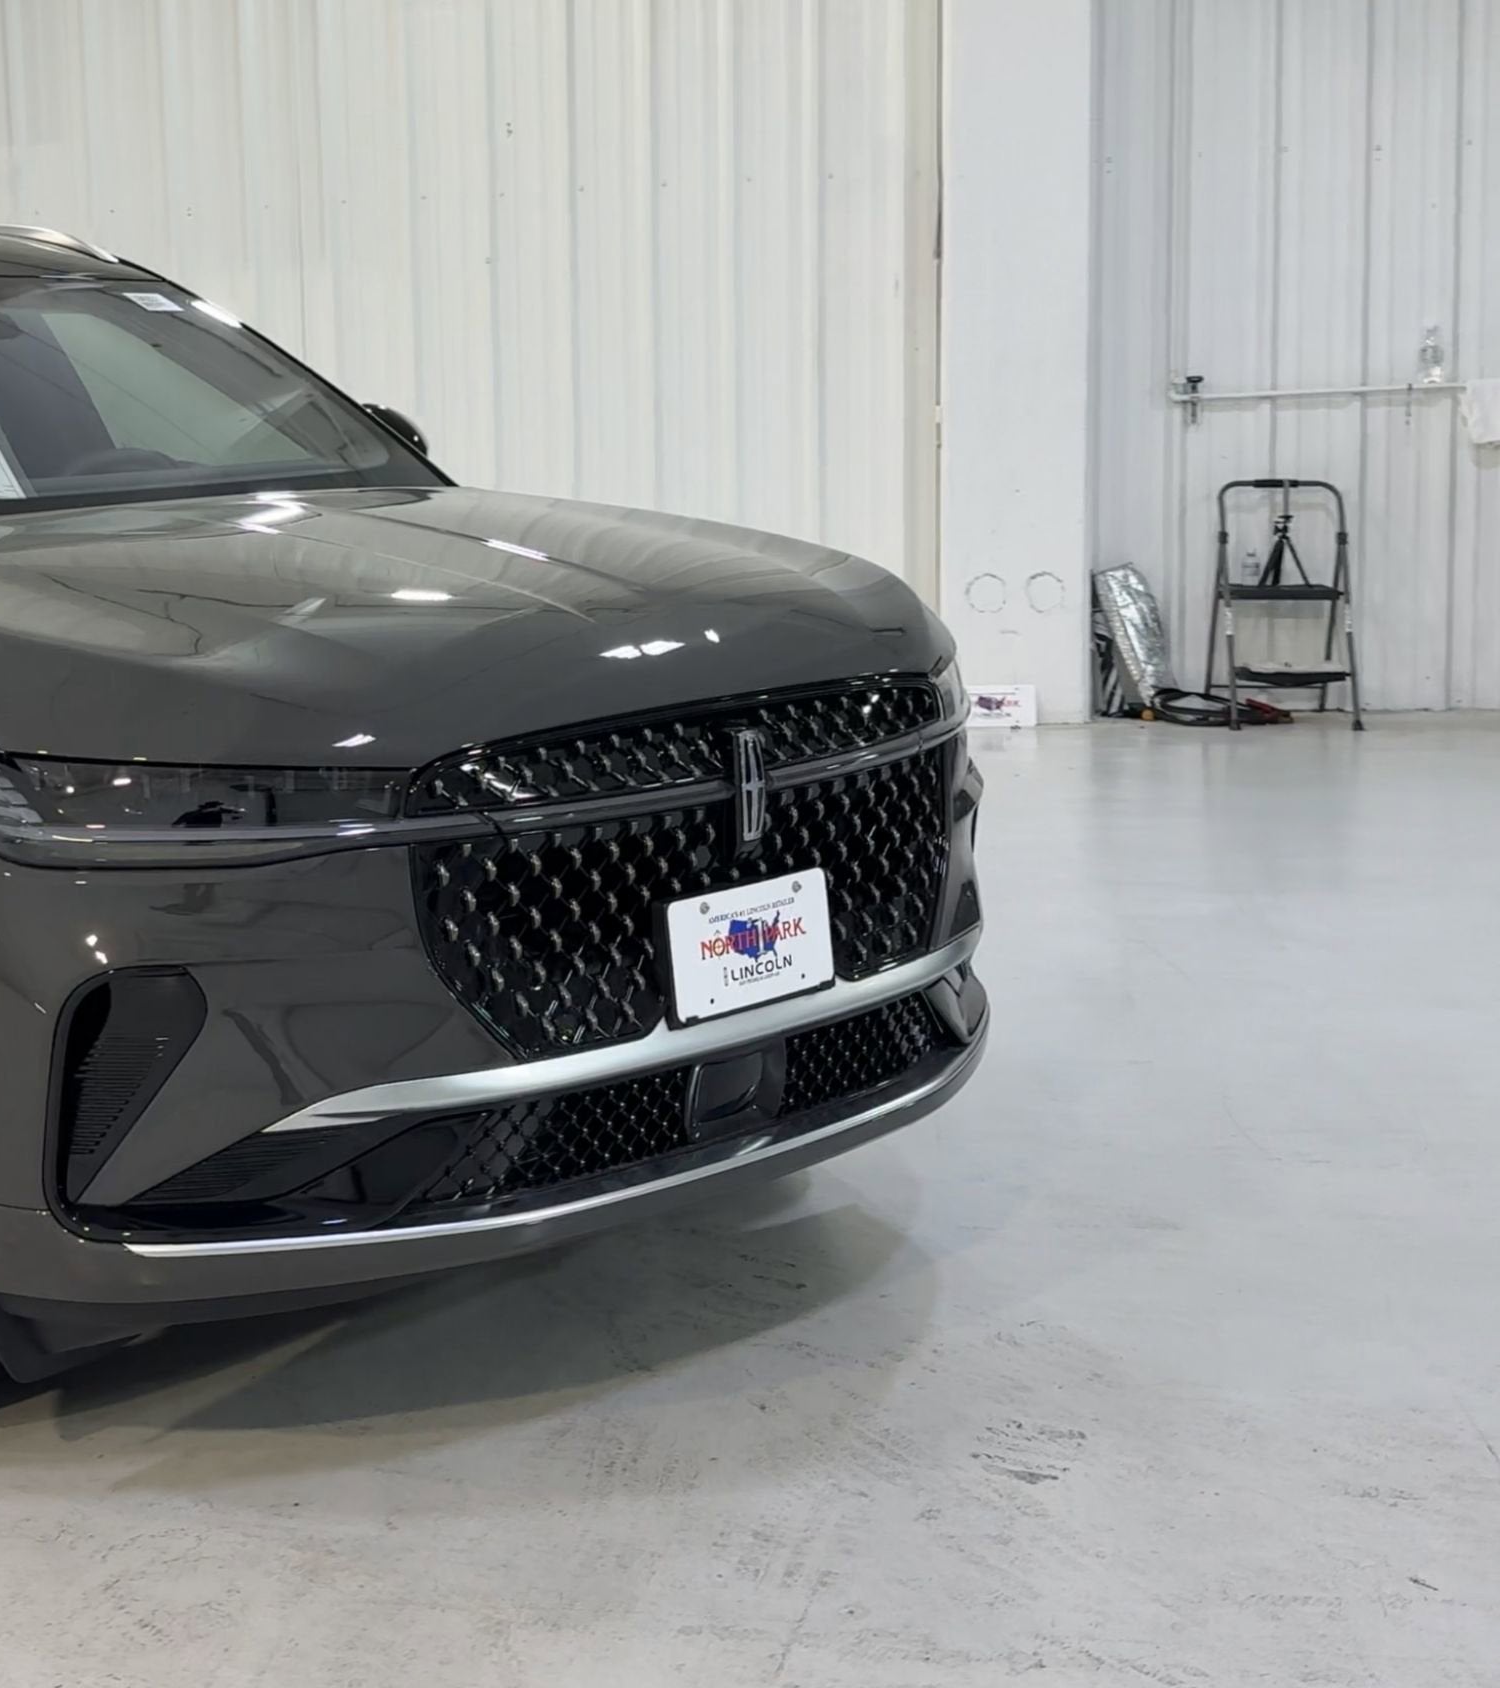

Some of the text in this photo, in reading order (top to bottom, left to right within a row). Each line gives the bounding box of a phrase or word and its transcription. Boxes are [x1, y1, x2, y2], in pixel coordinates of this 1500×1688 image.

[700, 917, 806, 960] NORTH PARK
[731, 955, 792, 981] LINCOLN
